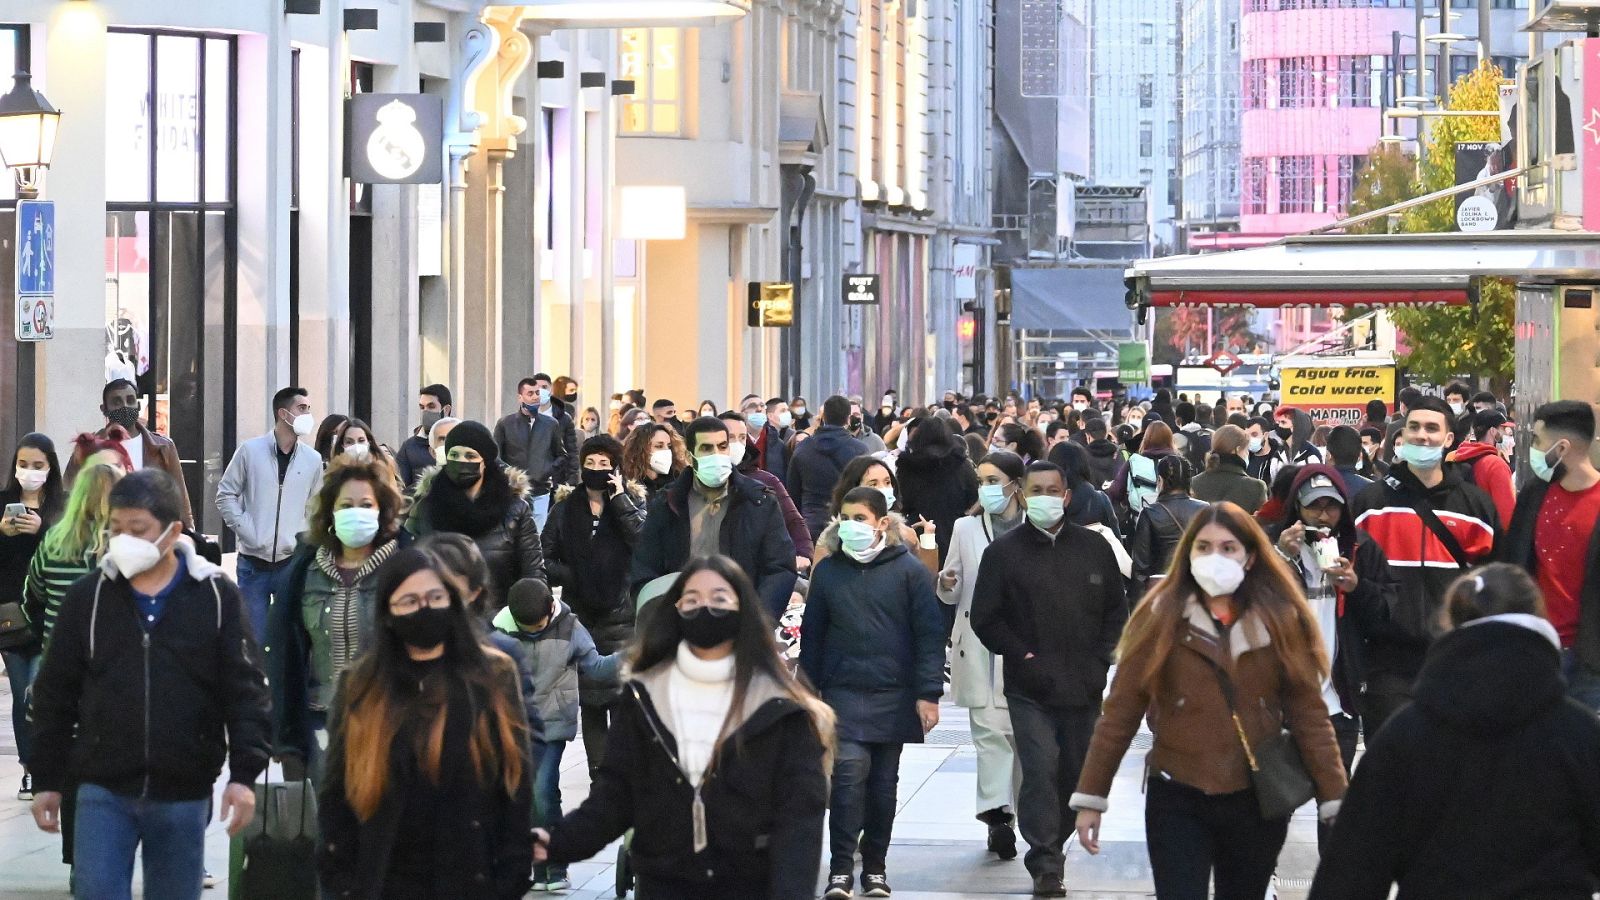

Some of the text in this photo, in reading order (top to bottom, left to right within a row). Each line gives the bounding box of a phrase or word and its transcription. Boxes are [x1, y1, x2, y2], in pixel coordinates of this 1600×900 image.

[1457, 143, 1484, 151] 17 NOV
[1295, 368, 1339, 380] Agua
[1290, 385, 1385, 396] Cold water.
[1310, 408, 1362, 421] MADRID
